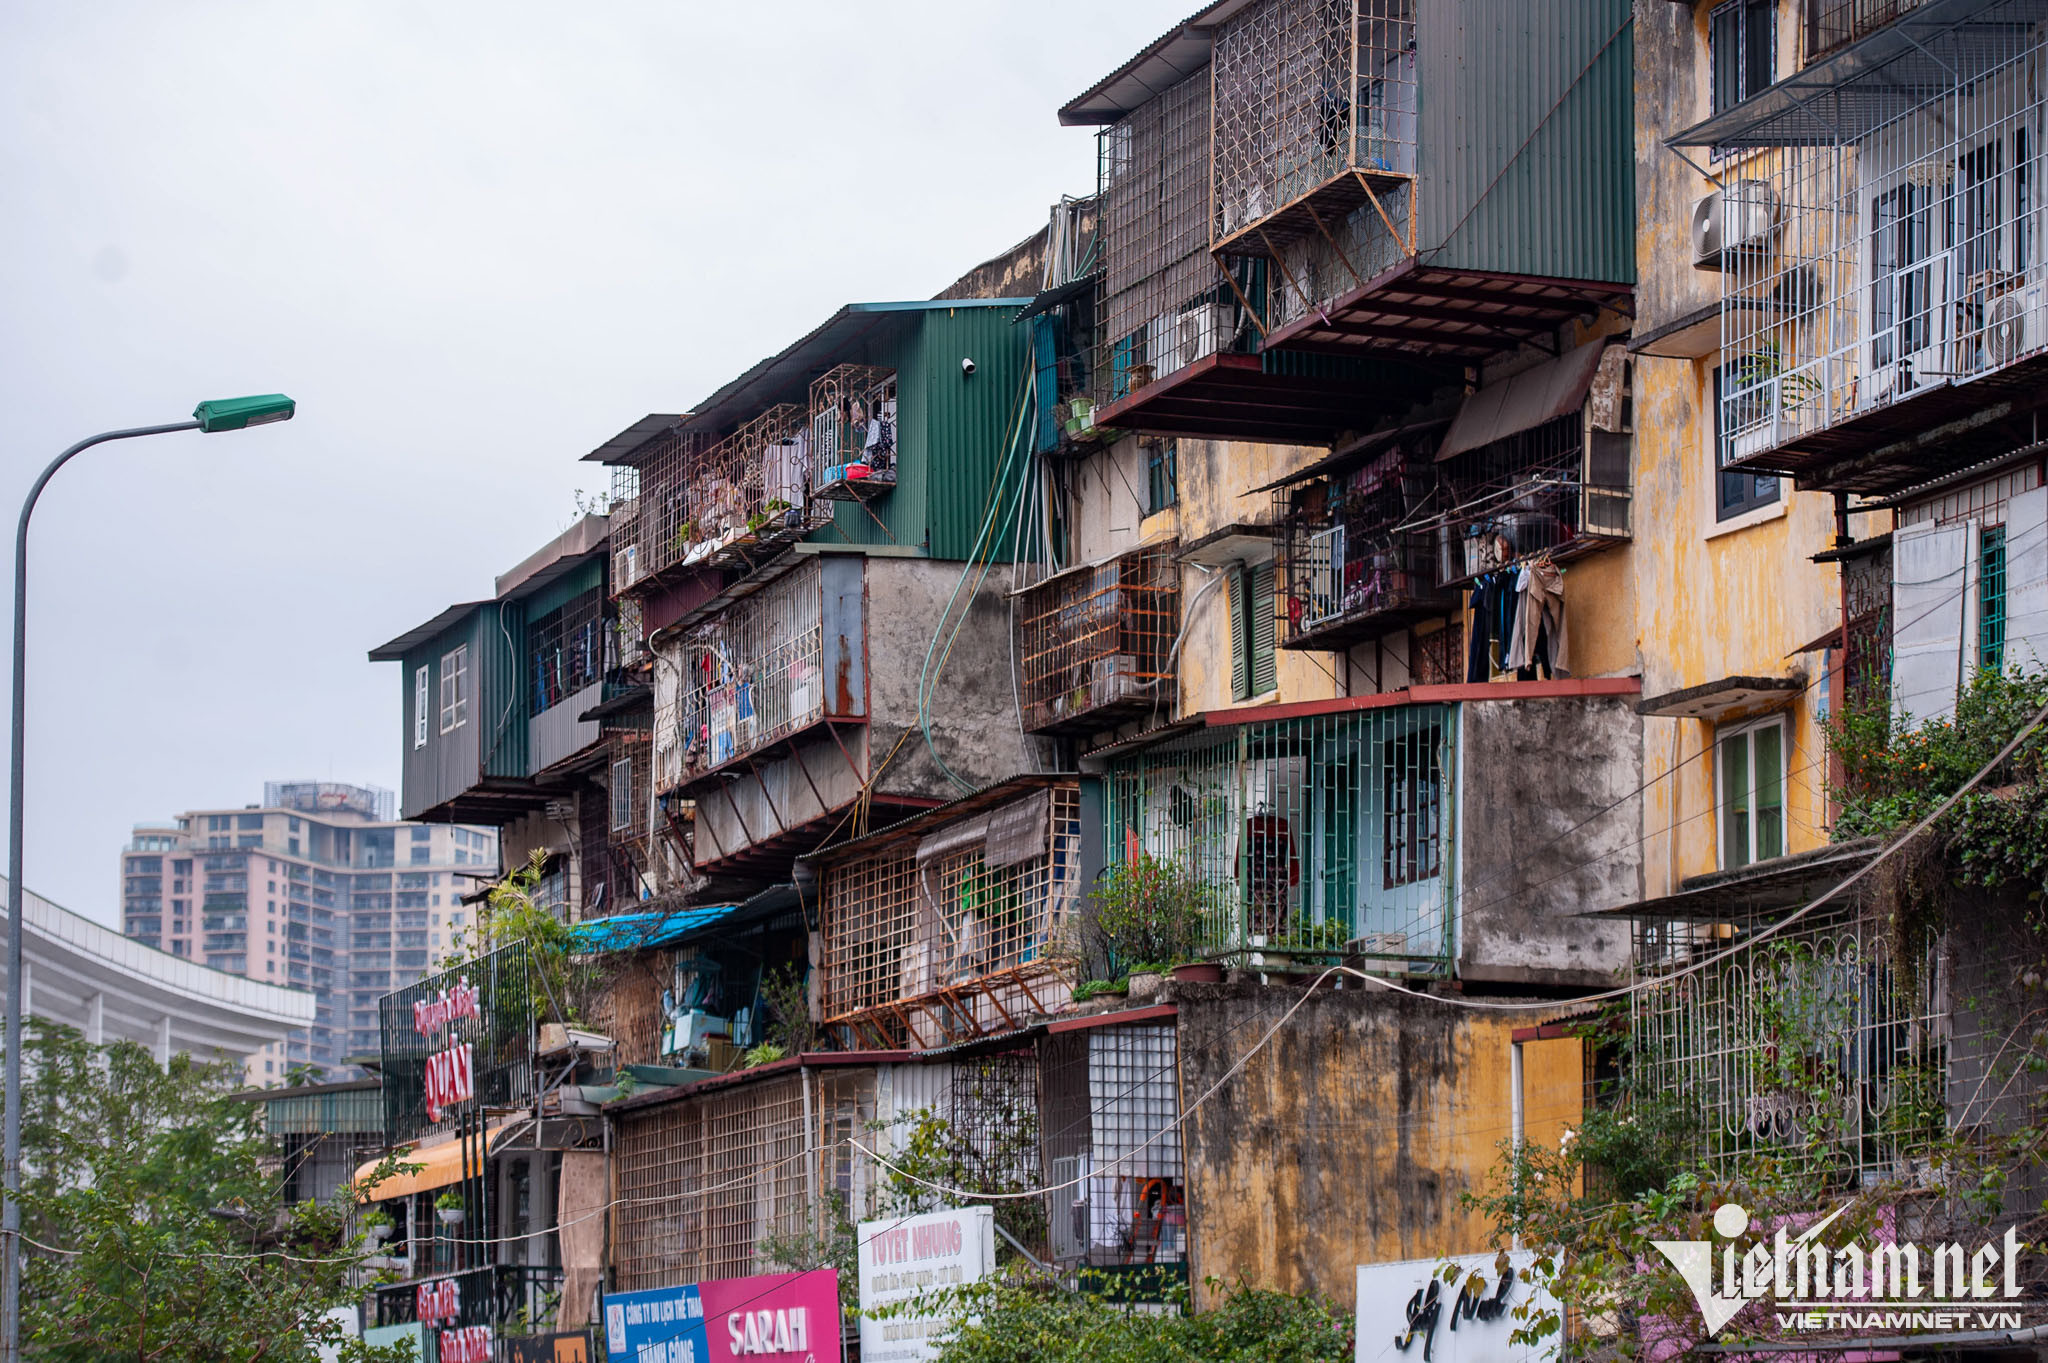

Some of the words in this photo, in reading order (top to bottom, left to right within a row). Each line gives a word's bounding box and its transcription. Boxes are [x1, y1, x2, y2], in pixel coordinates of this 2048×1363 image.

[912, 1220, 962, 1260] NHUNG
[625, 1301, 643, 1326] CÔNG
[642, 1303, 650, 1324] TY
[728, 1307, 808, 1356] SARAH
[668, 1335, 695, 1363] CÔNG
